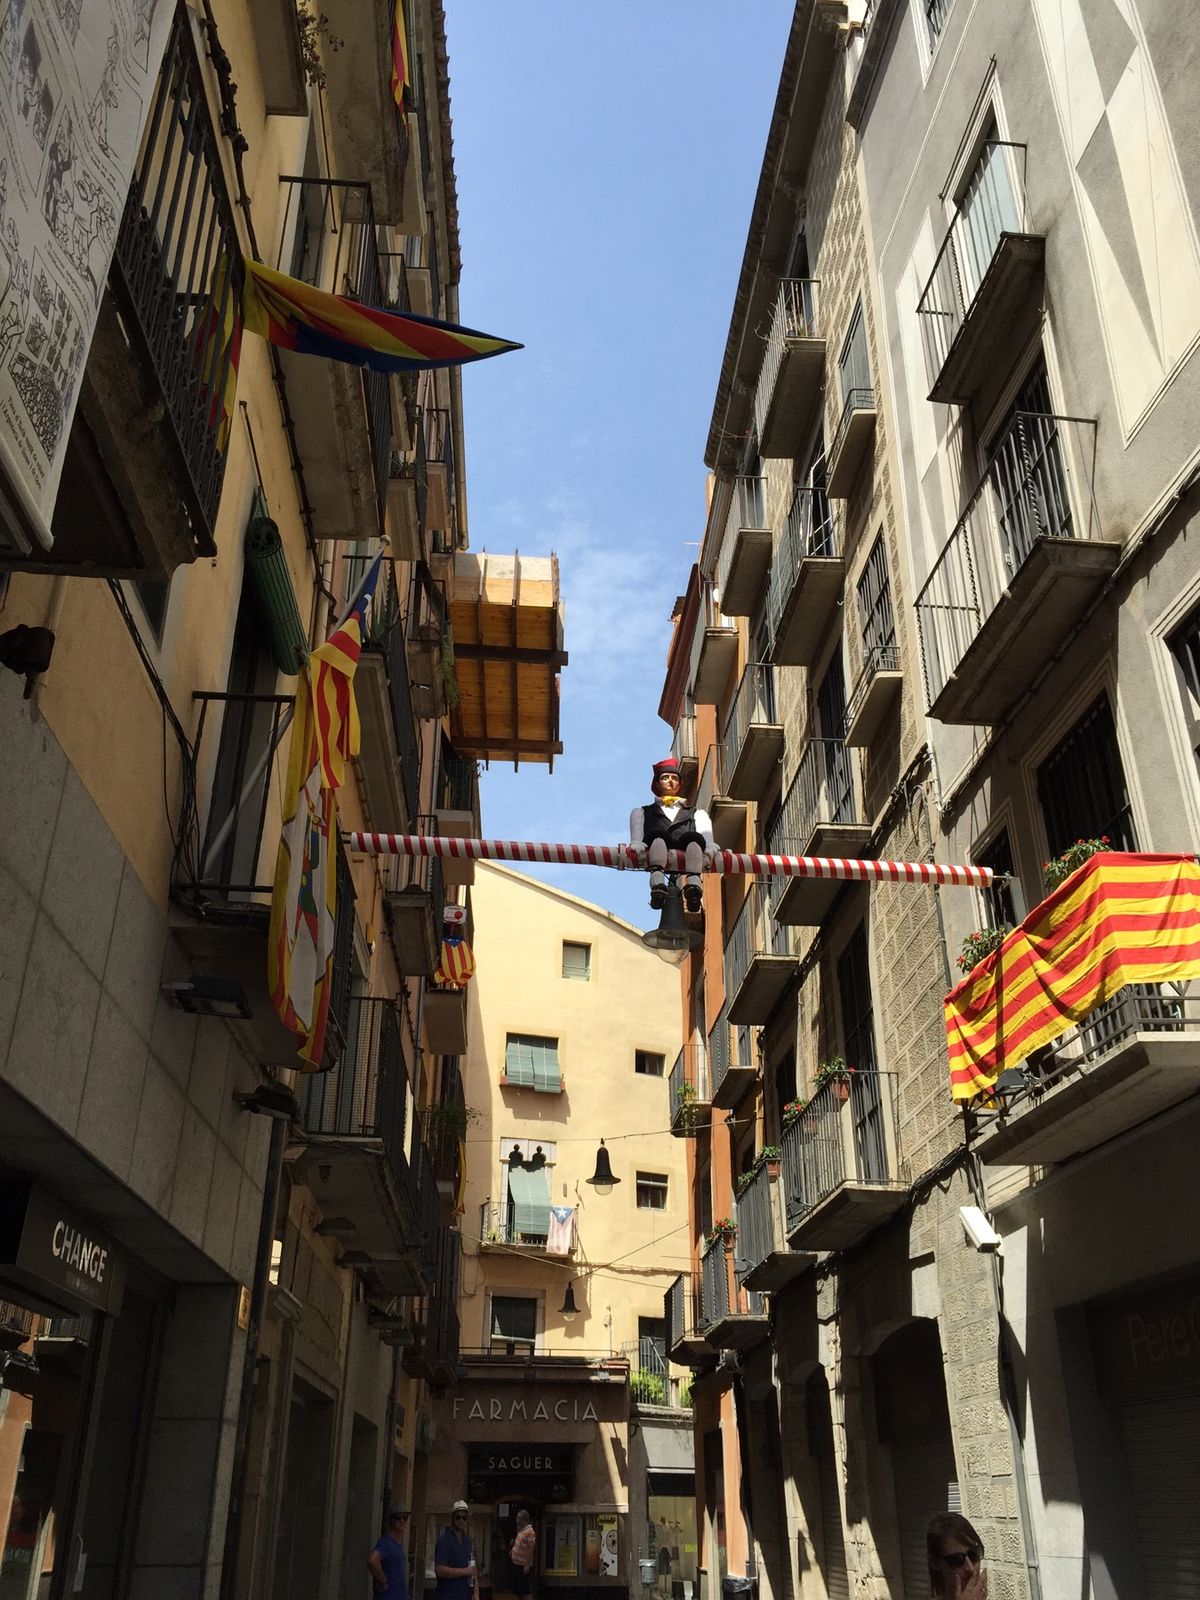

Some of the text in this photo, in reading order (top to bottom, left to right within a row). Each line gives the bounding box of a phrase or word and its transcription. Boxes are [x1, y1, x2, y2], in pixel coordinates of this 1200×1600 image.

[52, 1220, 108, 1283] CHANGE
[452, 1397, 599, 1422] FARMACIA
[488, 1456, 554, 1470] SAGUER
